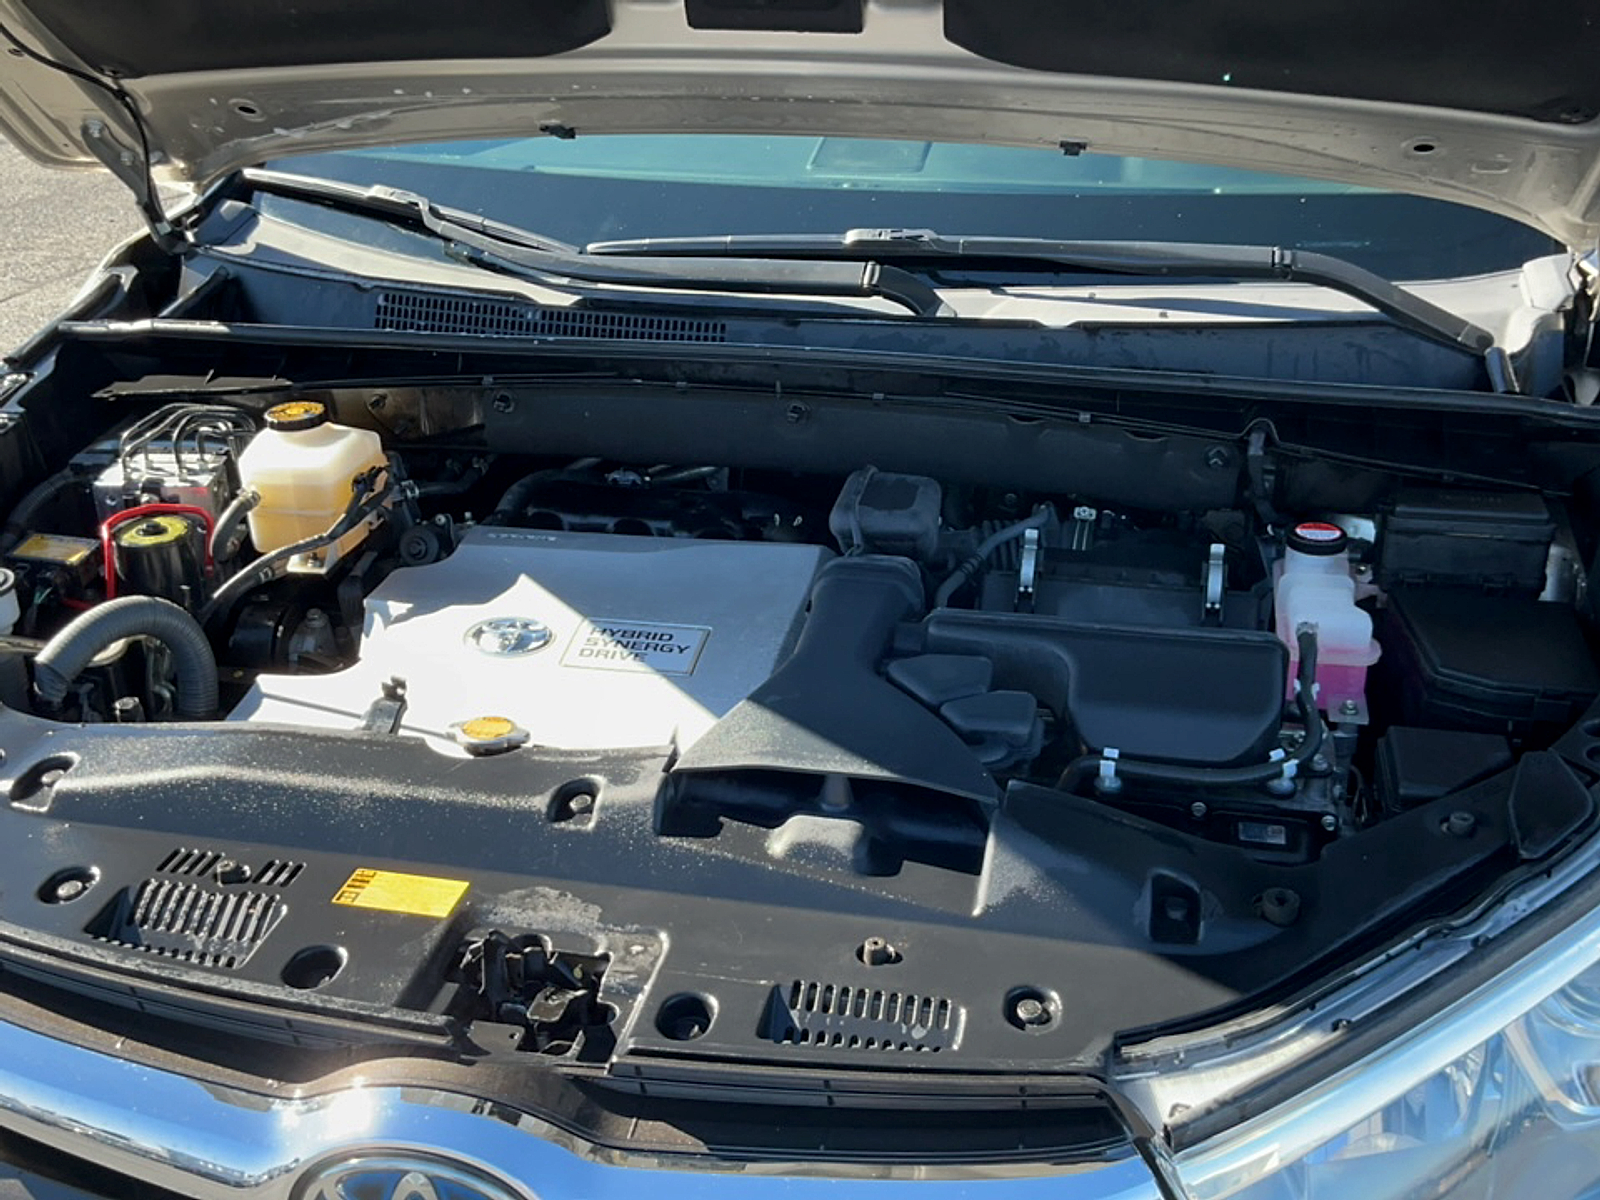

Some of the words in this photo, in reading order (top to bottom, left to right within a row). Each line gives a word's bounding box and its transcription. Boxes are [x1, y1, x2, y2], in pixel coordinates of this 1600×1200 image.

[590, 627, 674, 642] HYBRID
[584, 637, 691, 655] SYNERGY
[579, 648, 648, 662] DRIVE
